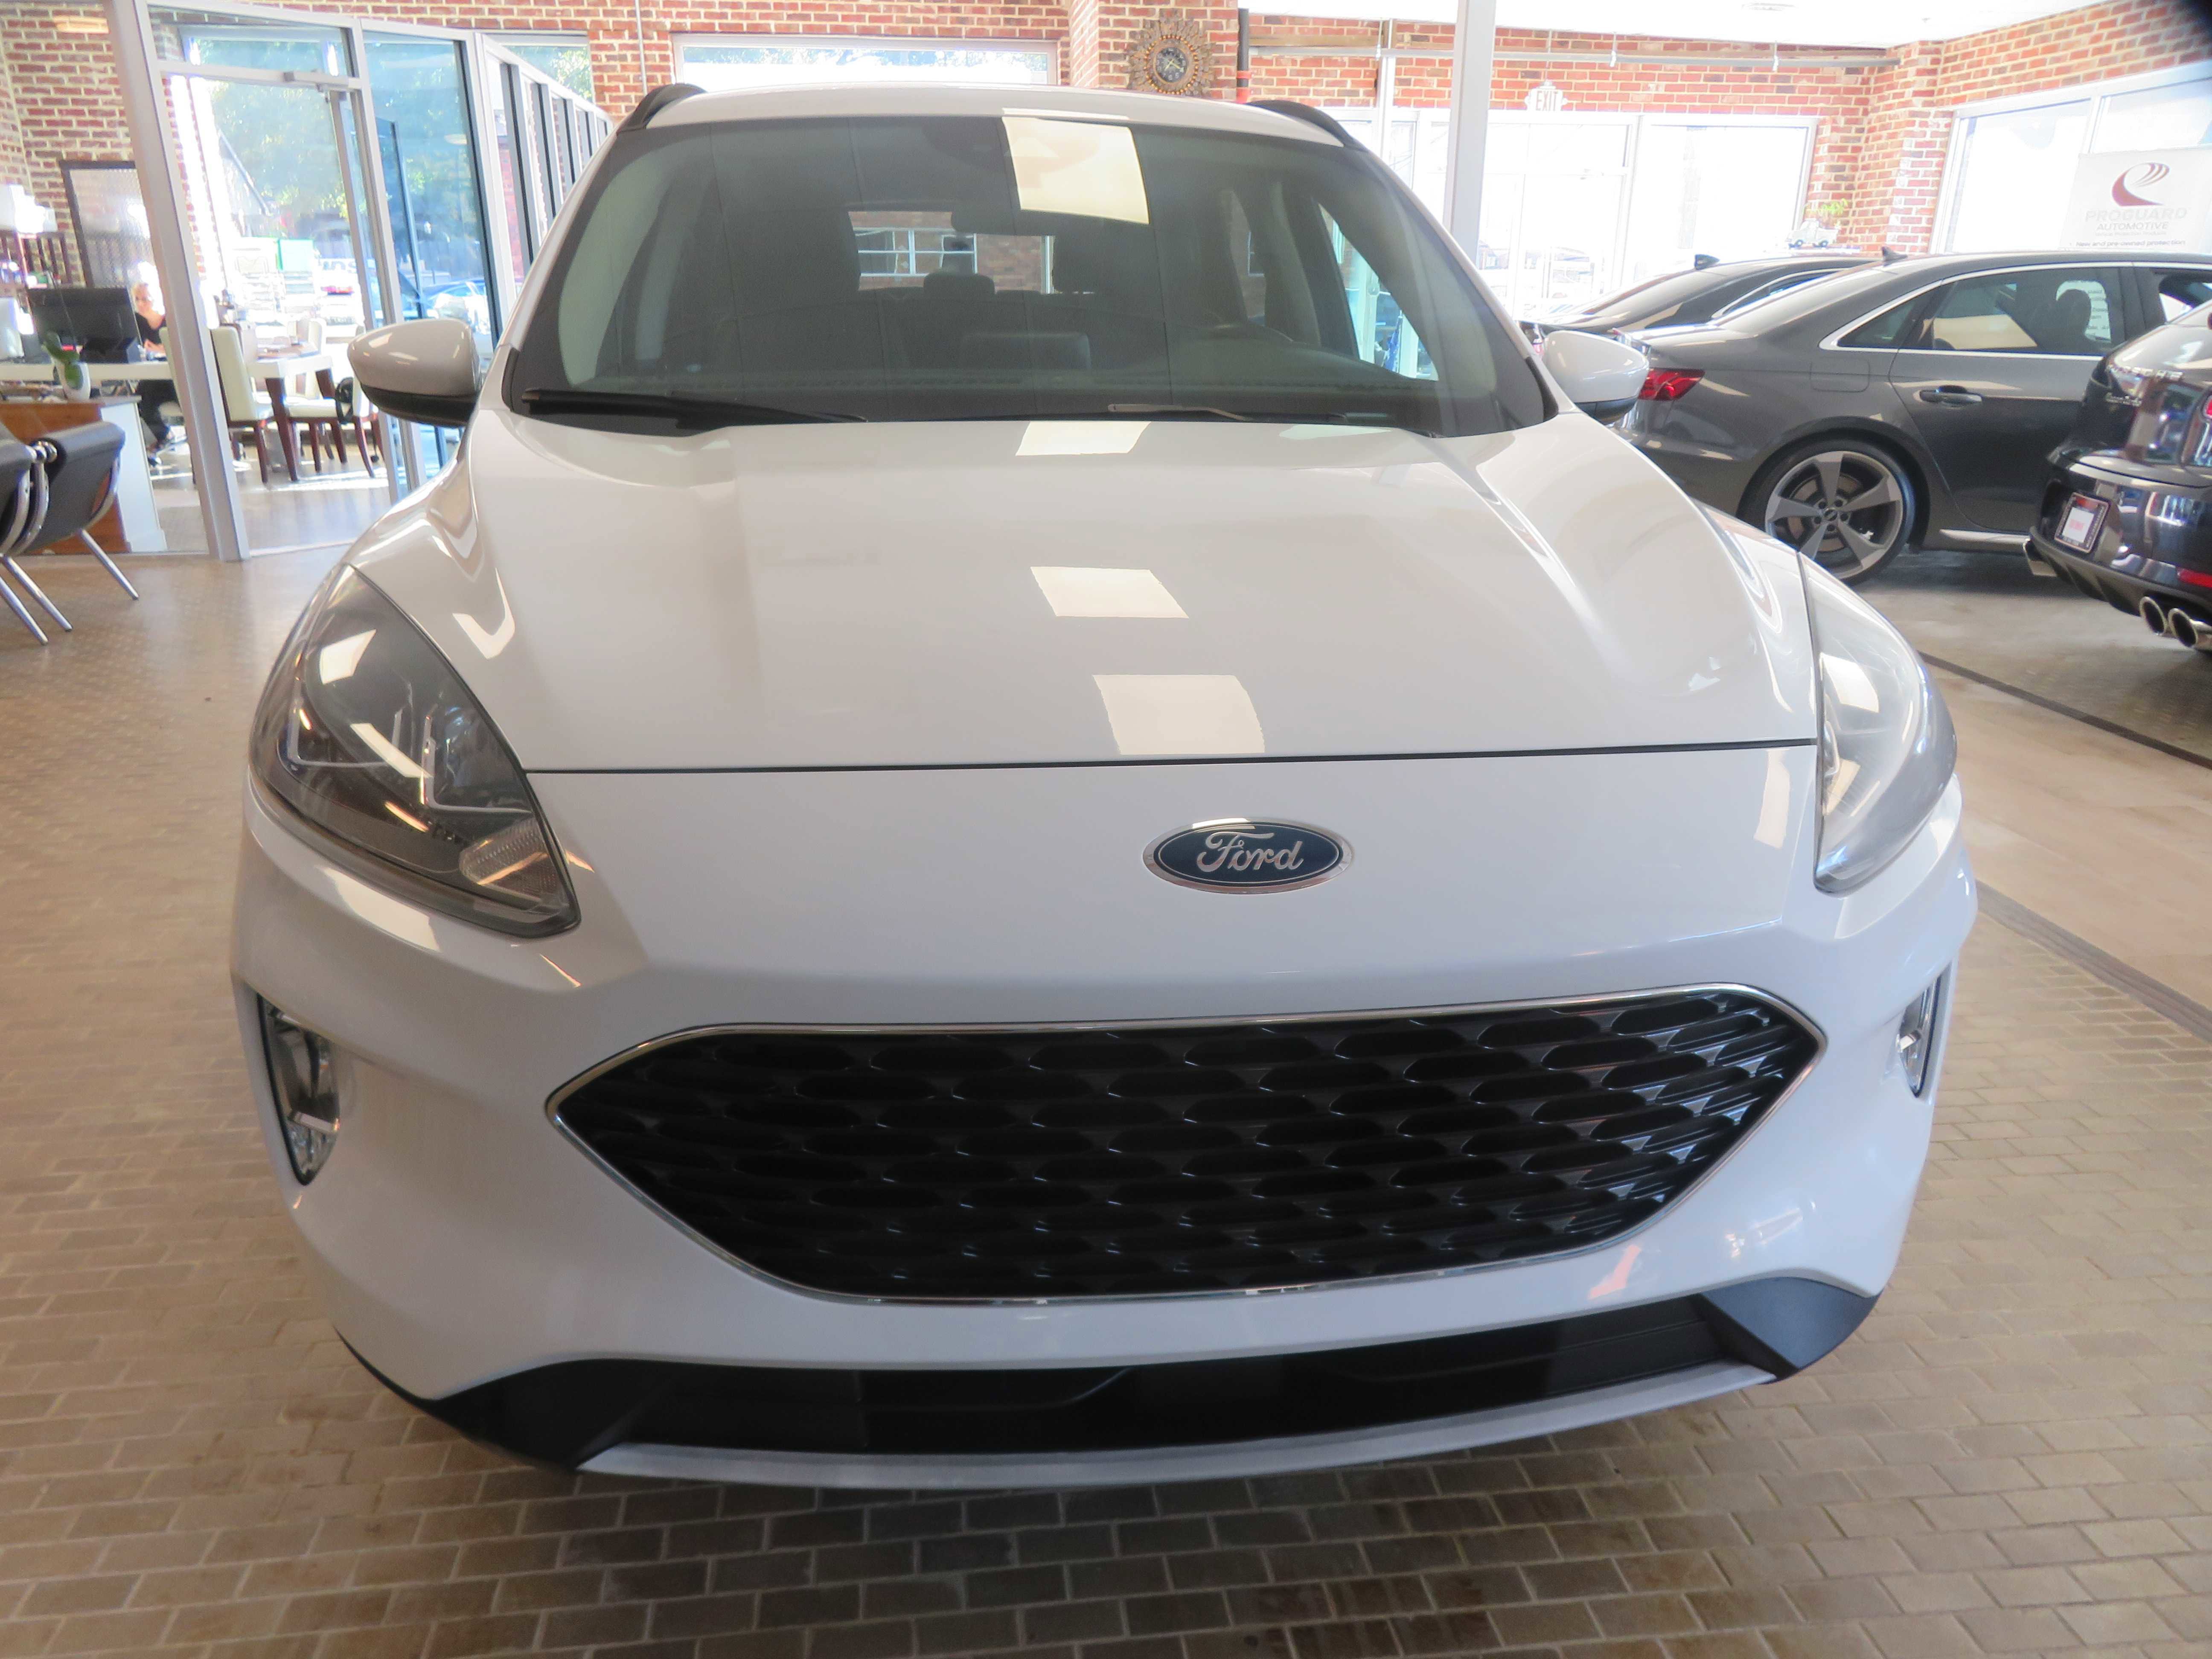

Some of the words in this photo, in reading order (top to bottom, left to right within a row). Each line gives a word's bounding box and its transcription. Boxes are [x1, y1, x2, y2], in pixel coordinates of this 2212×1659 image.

[1536, 90, 1558, 111] EXIT
[2085, 208, 2188, 222] PROGUARD
[2097, 222, 2168, 230] AUTOMOTIVE
[1196, 831, 1304, 873] Ford
